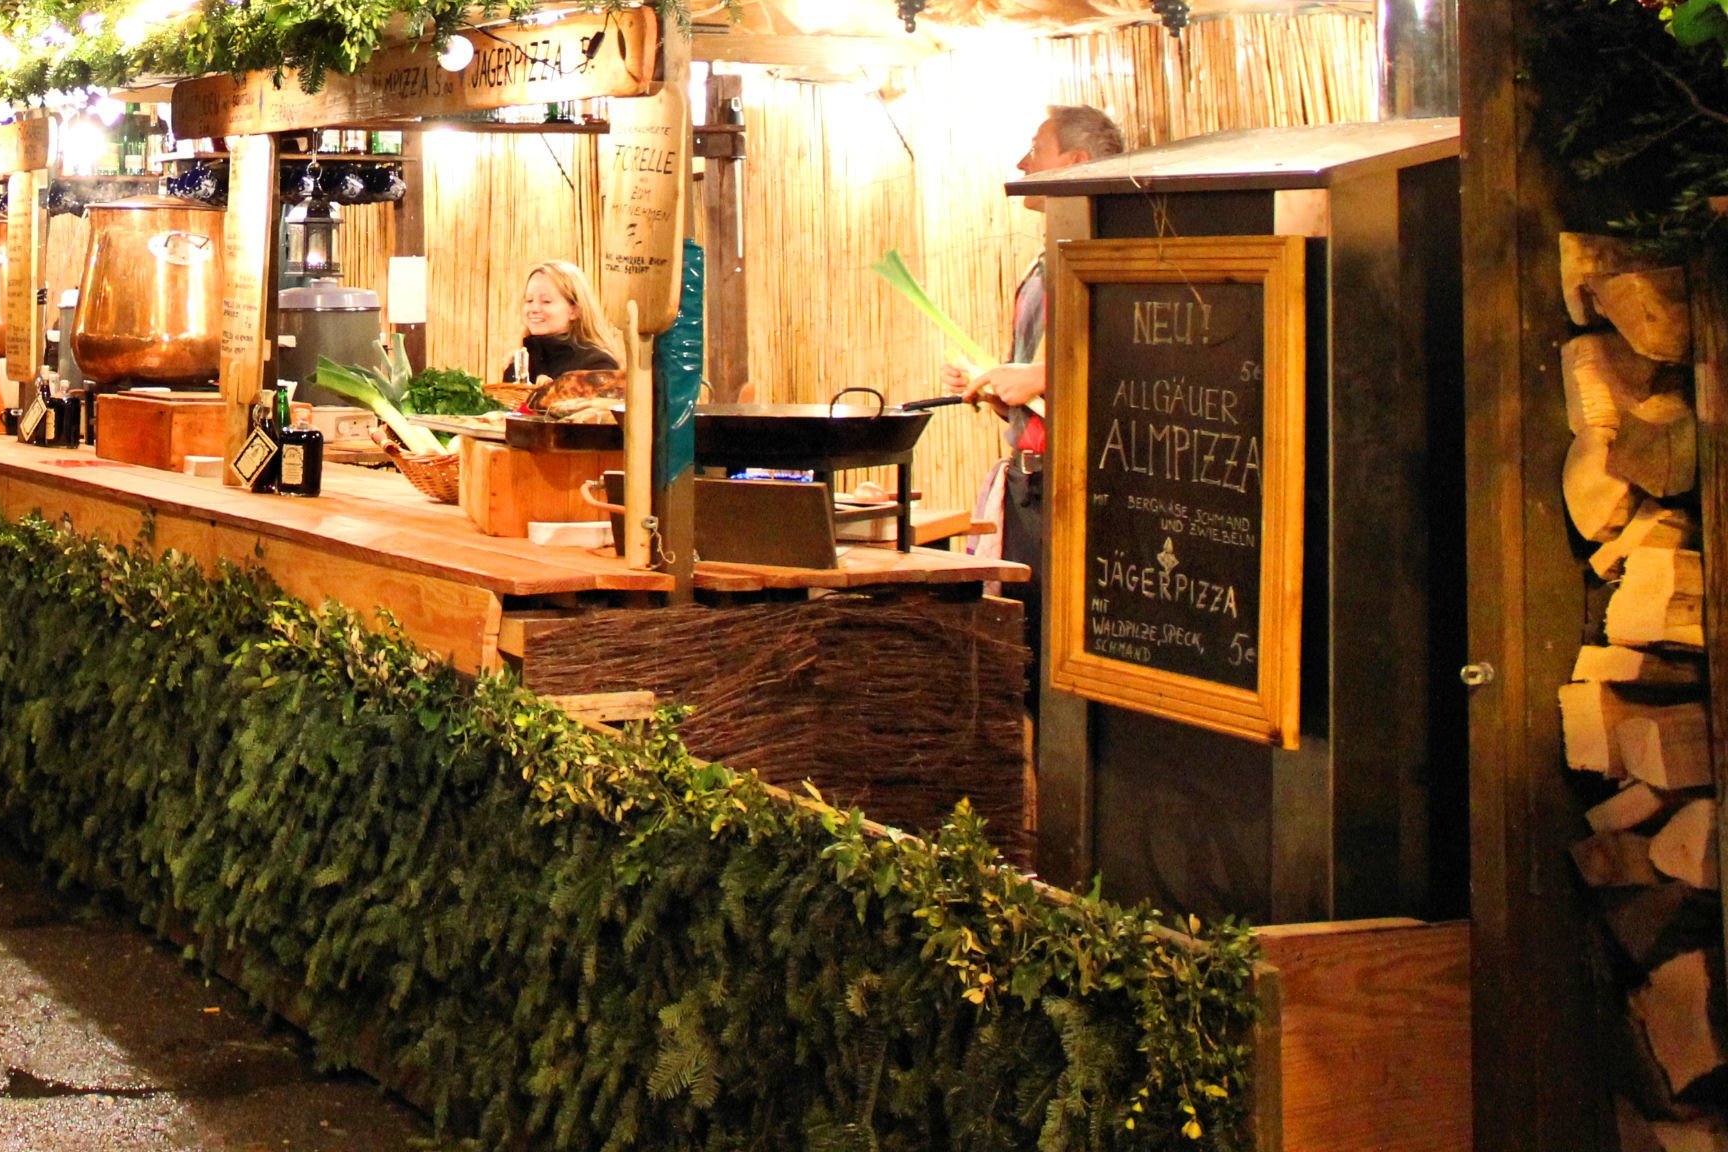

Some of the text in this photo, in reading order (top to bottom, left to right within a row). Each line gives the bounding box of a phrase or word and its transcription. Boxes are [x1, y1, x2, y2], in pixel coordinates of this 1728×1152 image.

[613, 144, 676, 175] FORELLE
[1111, 375, 1239, 425] ALLGÄUER
[1098, 418, 1263, 495] ALMPIZZA
[1092, 493, 1110, 506] MIT
[1194, 508, 1251, 532] SCHMAND
[1160, 518, 1256, 548] UND ZWIEBELN
[1096, 549, 1238, 619] JÄGERPIZZA
[1090, 597, 1110, 613] MIT
[1094, 638, 1152, 663] SCHMAND
